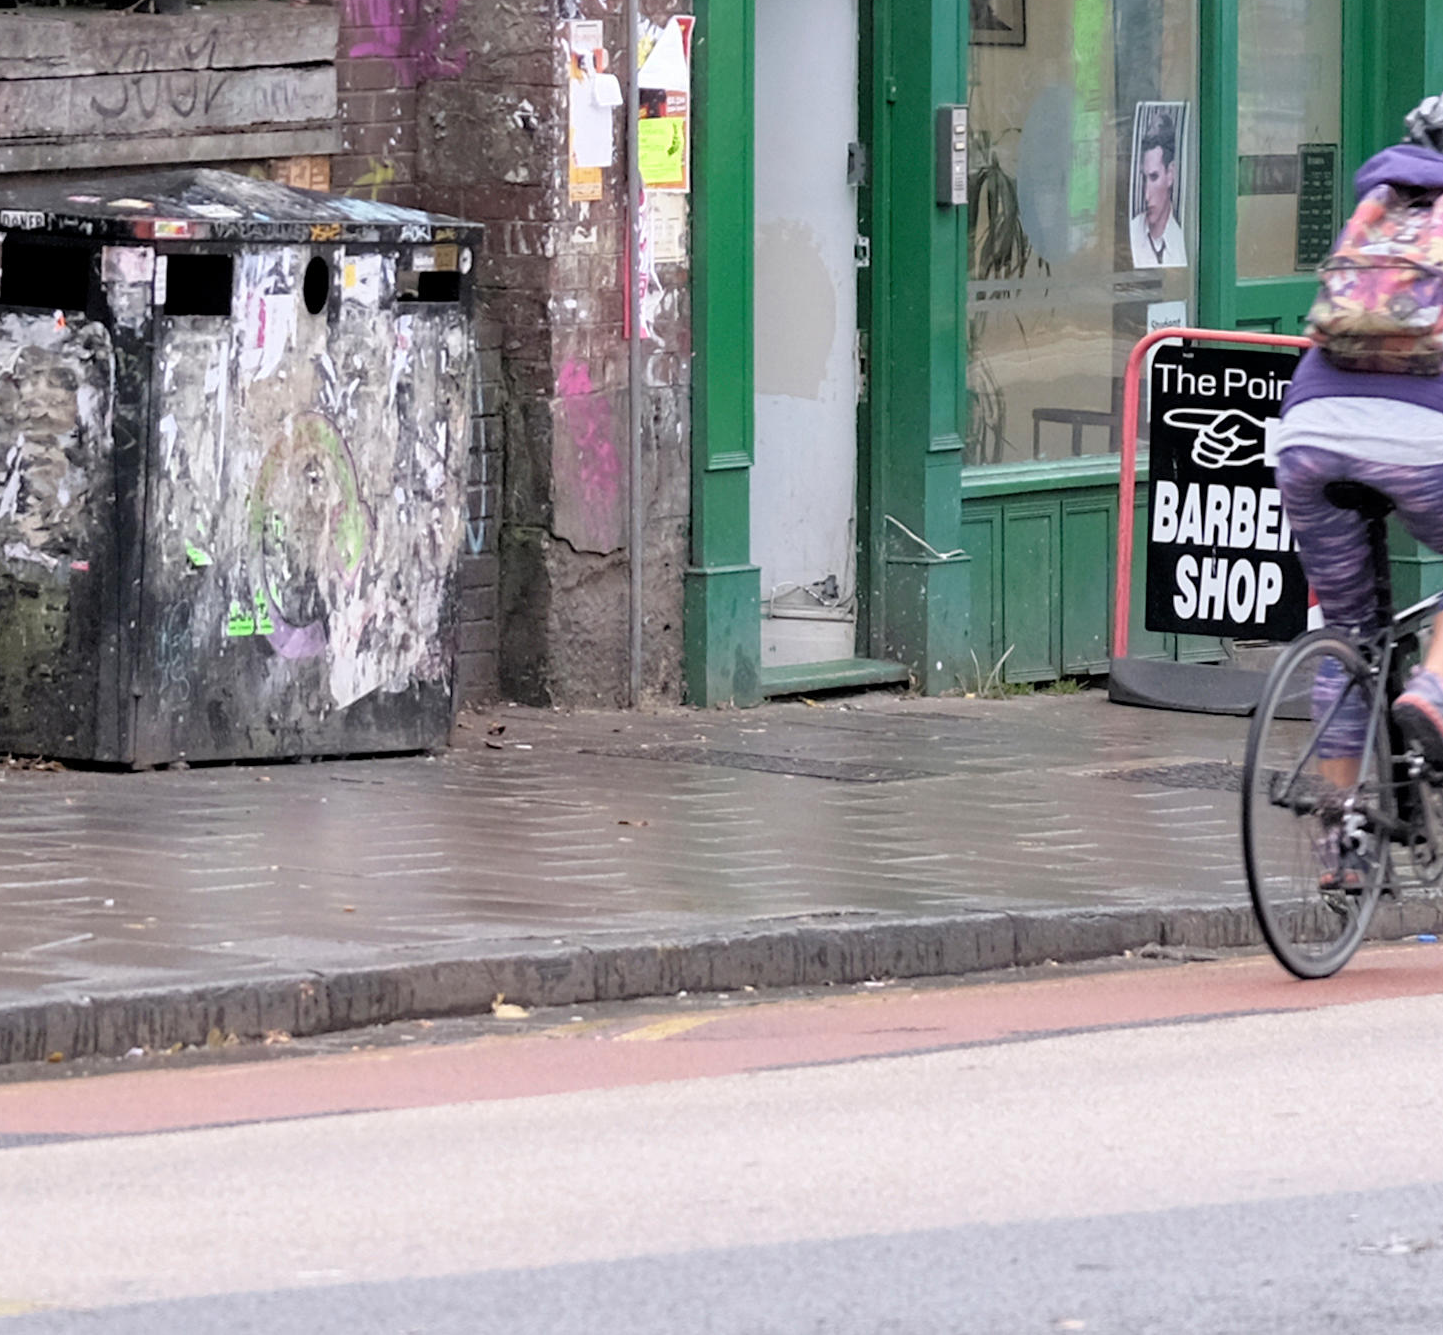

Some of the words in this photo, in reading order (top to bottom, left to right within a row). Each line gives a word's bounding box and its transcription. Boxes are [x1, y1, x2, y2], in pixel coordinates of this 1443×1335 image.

[1155, 363, 1216, 396] The
[1224, 368, 1293, 401] Poin
[1152, 480, 1300, 553] BARBE
[1173, 554, 1282, 624] SHOP
